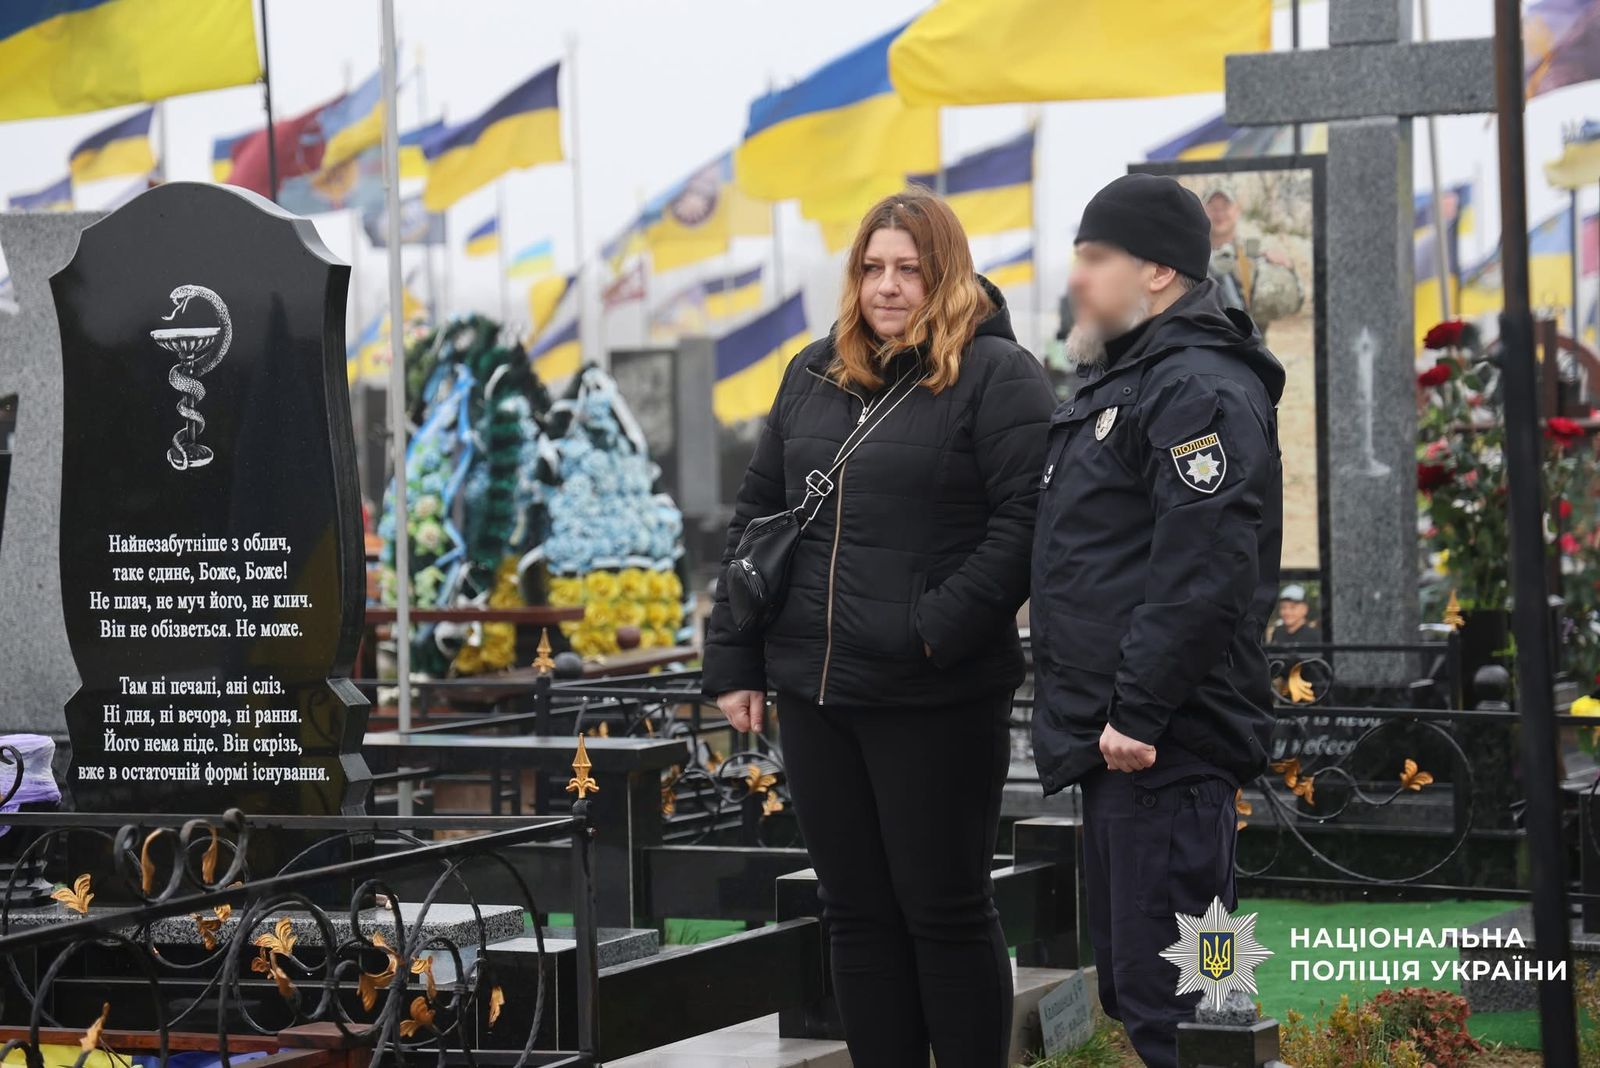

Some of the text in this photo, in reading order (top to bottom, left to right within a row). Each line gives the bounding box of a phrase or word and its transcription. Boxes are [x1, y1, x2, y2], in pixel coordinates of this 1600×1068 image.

[1174, 434, 1216, 457] ПОЛІЦІЯ
[108, 531, 292, 556] Найнезабутніше з облич,
[112, 560, 288, 584] таке єдине, Боже, Боже!
[89, 590, 313, 613] Не плач, не муч його, не клич.
[99, 618, 303, 638] Він не обізветься. Не може.
[118, 674, 286, 698] Там ні печалі, ані сліз.
[103, 703, 303, 728] Ні дня, ні вечора, ні рання.
[103, 730, 303, 757] Його нема ніде. Він скрізь,
[77, 761, 330, 786] вже в остаточній формі існування.
